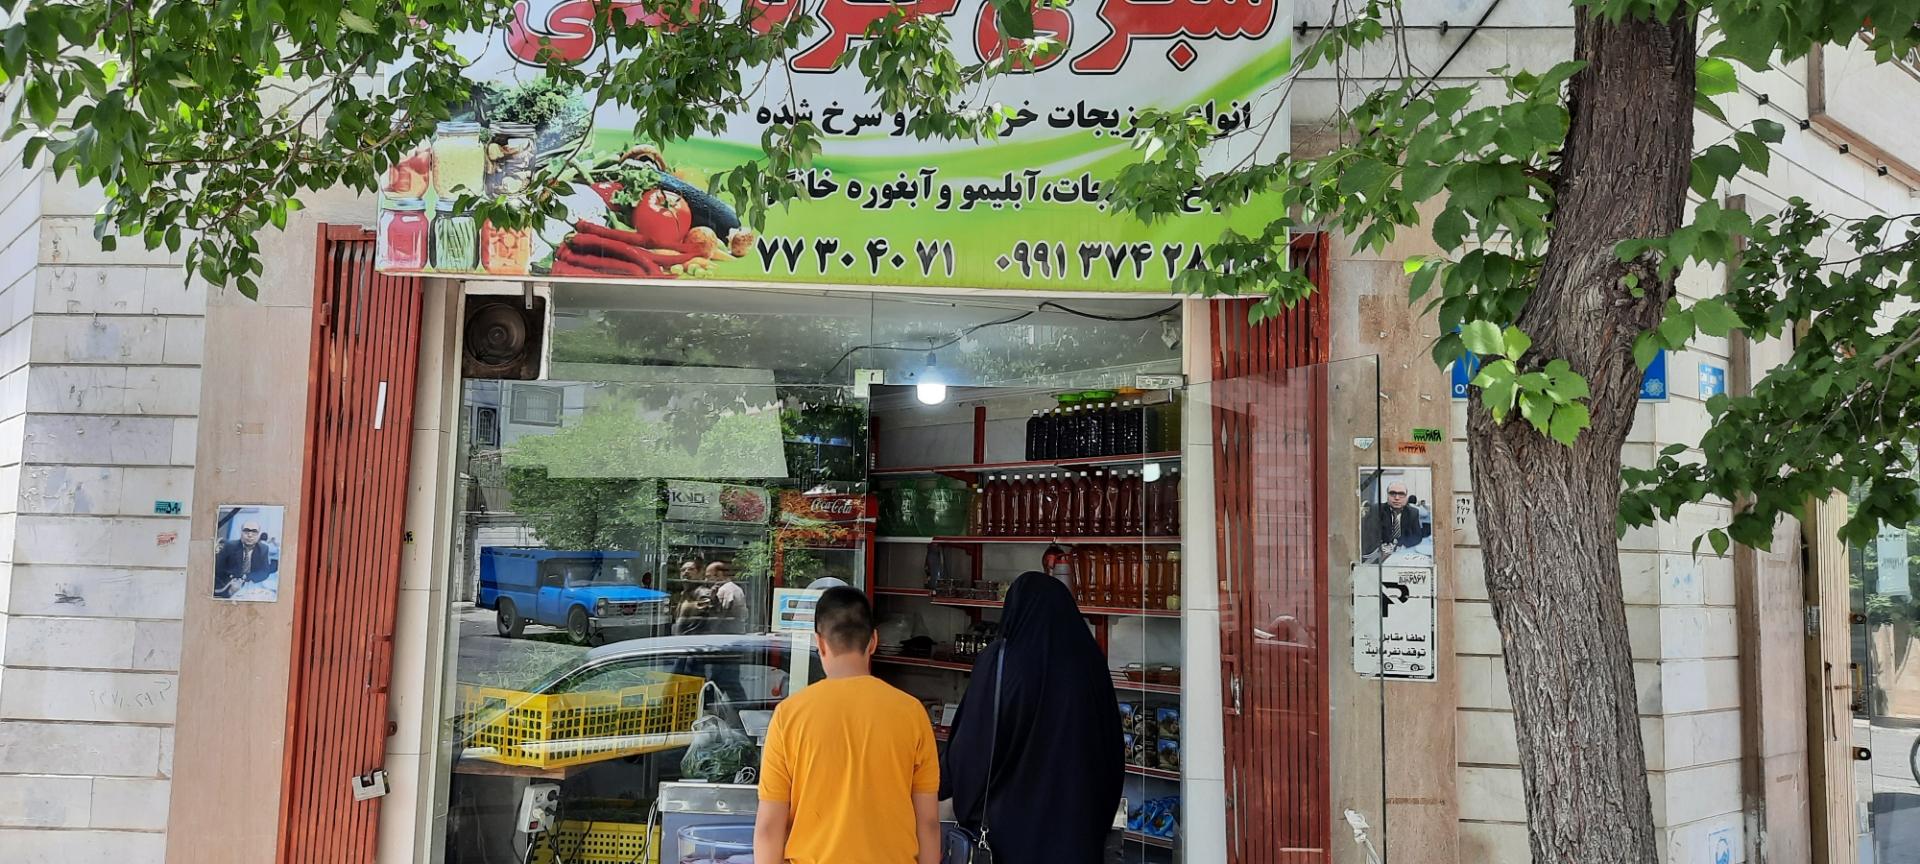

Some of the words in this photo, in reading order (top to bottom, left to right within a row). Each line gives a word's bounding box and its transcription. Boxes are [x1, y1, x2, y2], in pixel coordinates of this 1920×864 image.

[756, 98, 813, 127] شده
[821, 101, 883, 136] سرخ
[890, 111, 906, 136] و
[847, 168, 936, 209] آبغوره
[936, 184, 952, 210] و
[959, 168, 1041, 210] آبلیمو
[757, 238, 804, 273] ۷۷
[814, 238, 856, 274] ۳۰
[866, 239, 905, 275] ۴۰
[915, 240, 954, 276] ۷۱
[996, 241, 1066, 279] ۰۹۹۱
[1078, 243, 1152, 280] ۳۷۴
